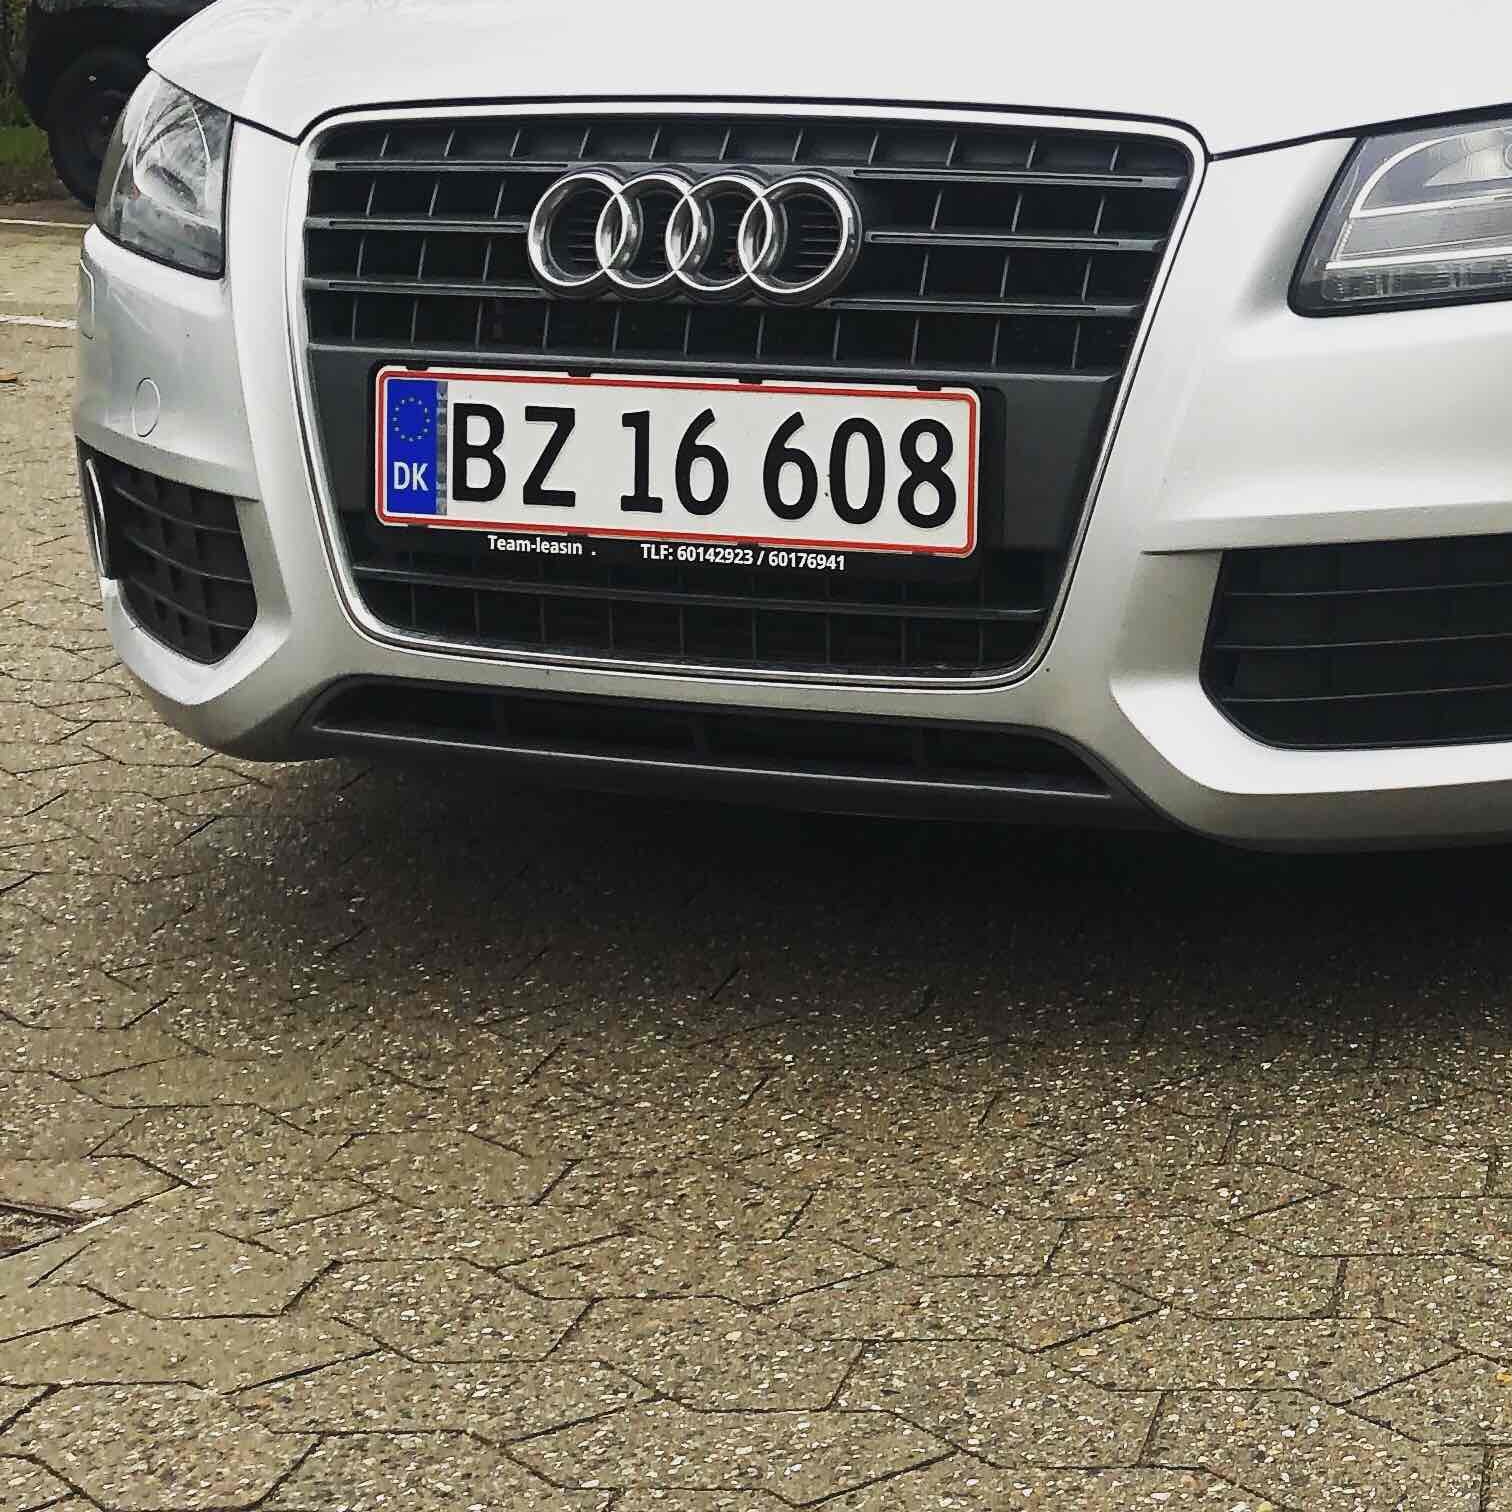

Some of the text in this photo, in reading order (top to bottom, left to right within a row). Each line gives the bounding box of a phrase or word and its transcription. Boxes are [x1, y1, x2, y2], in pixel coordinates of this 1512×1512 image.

[393, 461, 429, 491] DK
[452, 402, 957, 529] BZ 16 608
[640, 543, 674, 561] TLF:
[676, 545, 754, 565] 60142923
[768, 550, 845, 571] 60176941
